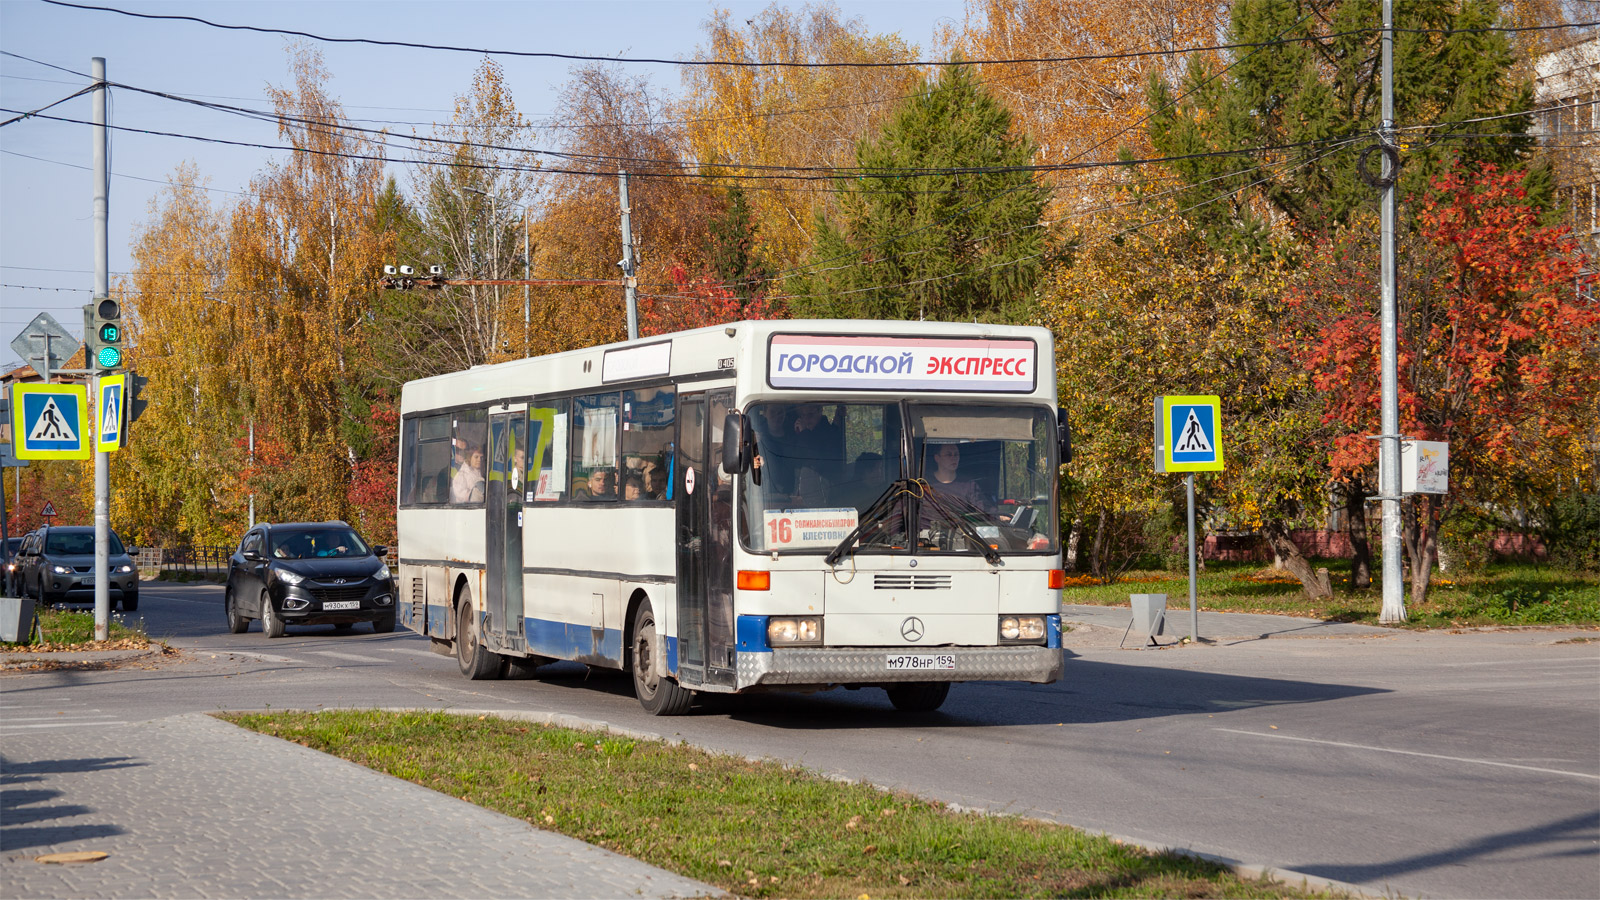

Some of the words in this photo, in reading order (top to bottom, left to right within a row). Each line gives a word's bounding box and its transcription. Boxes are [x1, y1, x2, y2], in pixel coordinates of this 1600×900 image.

[104, 328, 117, 341] 19
[723, 359, 734, 367] 405
[778, 352, 914, 374] ГОРОДСКОЙ
[926, 356, 1027, 376] ЭКСПРЕСС
[768, 518, 792, 543] 16
[889, 656, 933, 668] М978НР
[936, 656, 952, 664] 159
